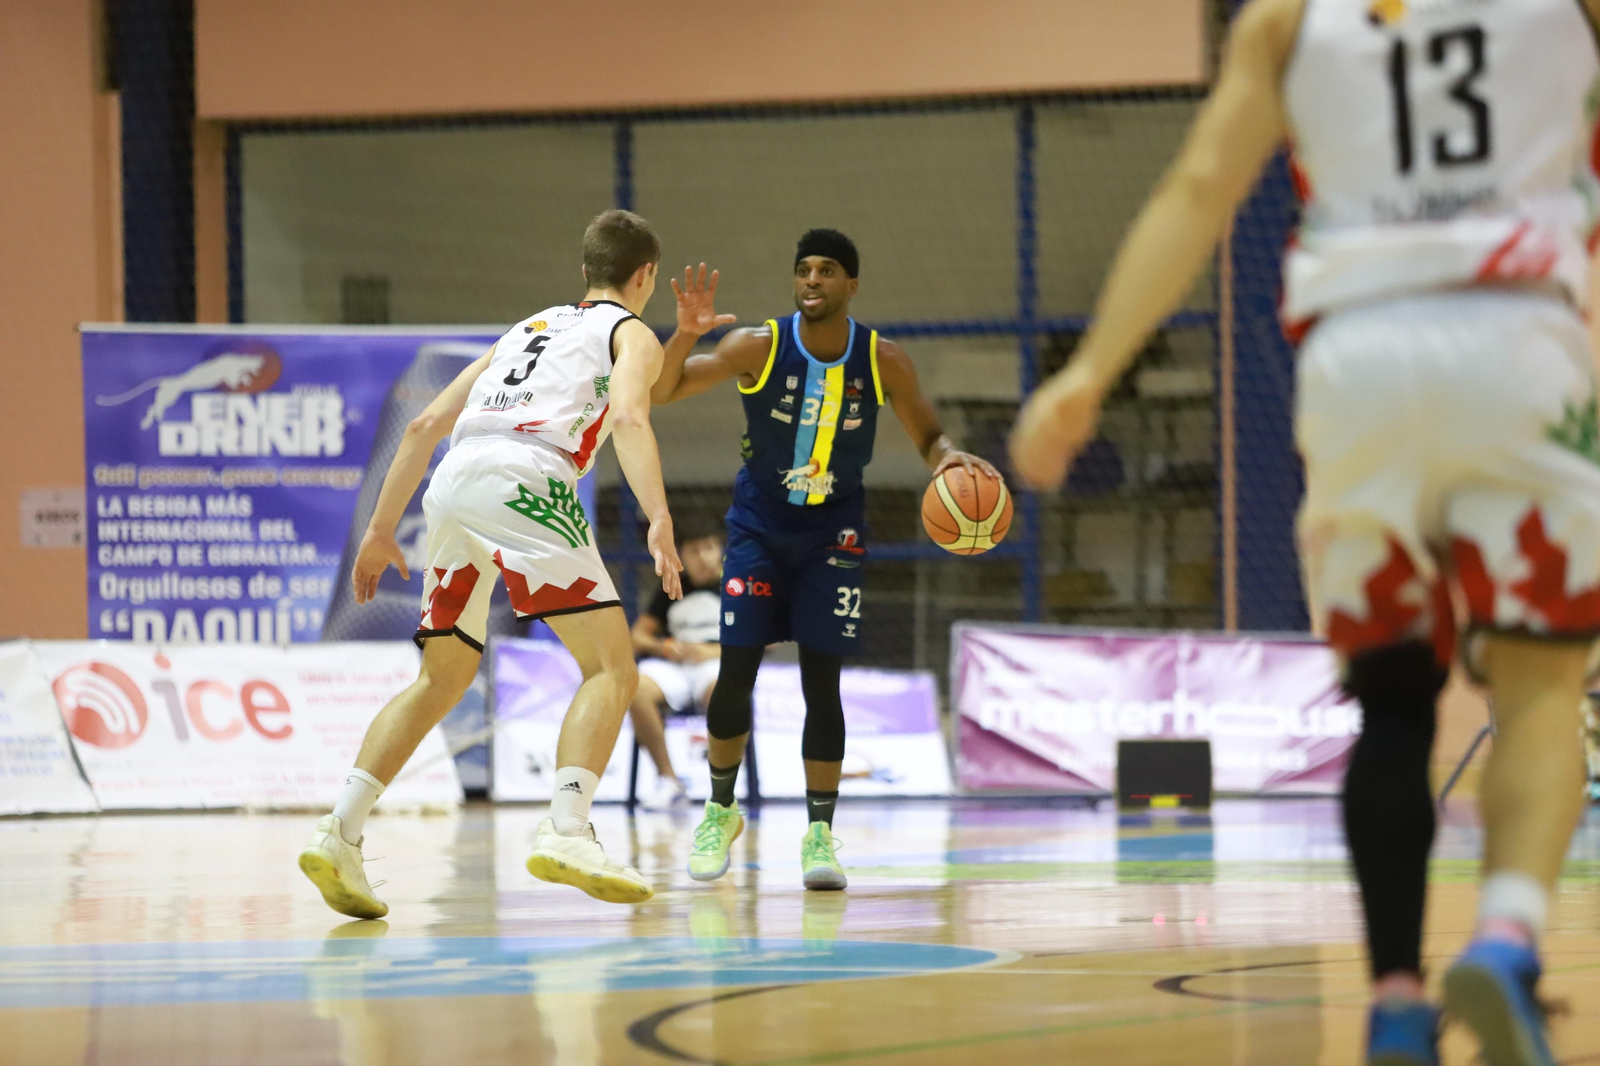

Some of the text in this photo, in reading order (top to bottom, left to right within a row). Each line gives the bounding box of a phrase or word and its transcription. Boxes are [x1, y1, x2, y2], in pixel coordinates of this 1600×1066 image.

[1388, 25, 1490, 175] 13
[503, 335, 551, 386] 5
[192, 392, 344, 426] ENER
[800, 397, 838, 427] 32
[158, 422, 344, 456] DRINK
[97, 495, 123, 517] LA
[127, 495, 202, 517] BEBIDA
[206, 490, 253, 517] MÁS
[98, 519, 254, 542] INTERNACIONAL
[258, 519, 297, 541] DEL
[98, 543, 173, 566] CAMPO
[177, 543, 203, 566] DE
[100, 571, 332, 604] Orgullosos de ser
[746, 577, 772, 597] ice
[833, 587, 861, 618] 32
[152, 653, 293, 742] ice
